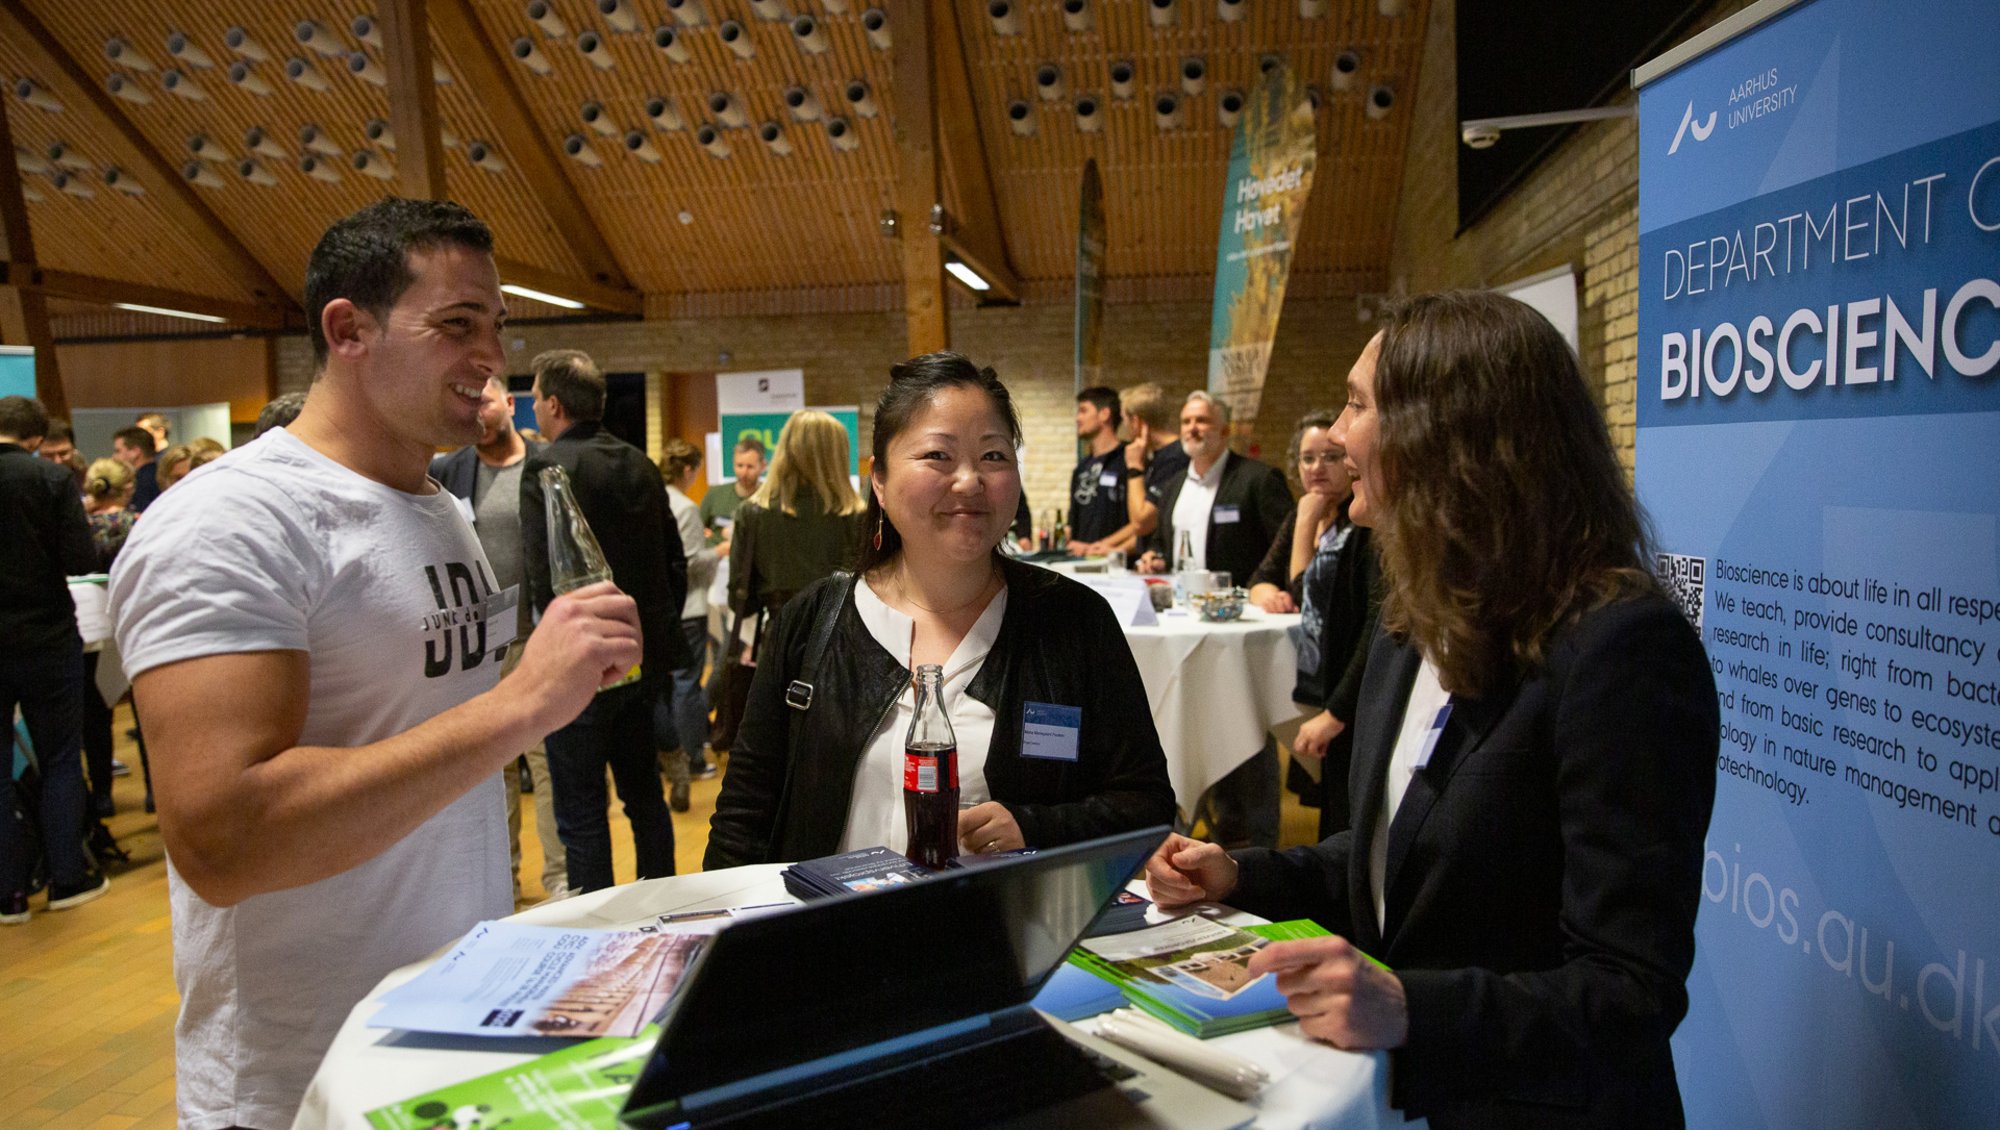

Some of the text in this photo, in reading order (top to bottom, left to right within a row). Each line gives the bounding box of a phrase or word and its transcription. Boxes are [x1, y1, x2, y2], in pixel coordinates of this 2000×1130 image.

[1728, 67, 1778, 106] AARHUS
[1728, 84, 1798, 129] UNIVERSITY
[1663, 173, 1946, 301] DEPARTMENT
[1716, 559, 1789, 589] Bioscience
[1793, 569, 1804, 591] is
[1808, 573, 1859, 600] about
[1864, 578, 1888, 604] life
[1893, 582, 1910, 608] in
[1917, 587, 1941, 612] all
[420, 608, 458, 631] JUNK
[1714, 590, 1736, 613] We
[1741, 597, 1786, 626] teach,
[1794, 609, 1858, 636] provide
[1866, 622, 1986, 666] consultancy
[1711, 655, 1724, 674] to
[1728, 660, 1778, 689] whales
[1784, 677, 1819, 699] over
[1826, 687, 1877, 716] genes
[1884, 699, 1902, 723] to
[1713, 627, 1769, 653] research
[1779, 635, 1791, 659] in
[1801, 640, 1830, 670] life;
[1841, 649, 1877, 679] right
[1888, 659, 1933, 691] from
[1742, 693, 1774, 722] from
[1782, 705, 1823, 737] basic
[1833, 724, 1905, 764] research
[1917, 746, 1938, 772] to
[1763, 733, 1776, 757] in
[1784, 745, 1837, 777] nature
[1845, 765, 1977, 828] management
